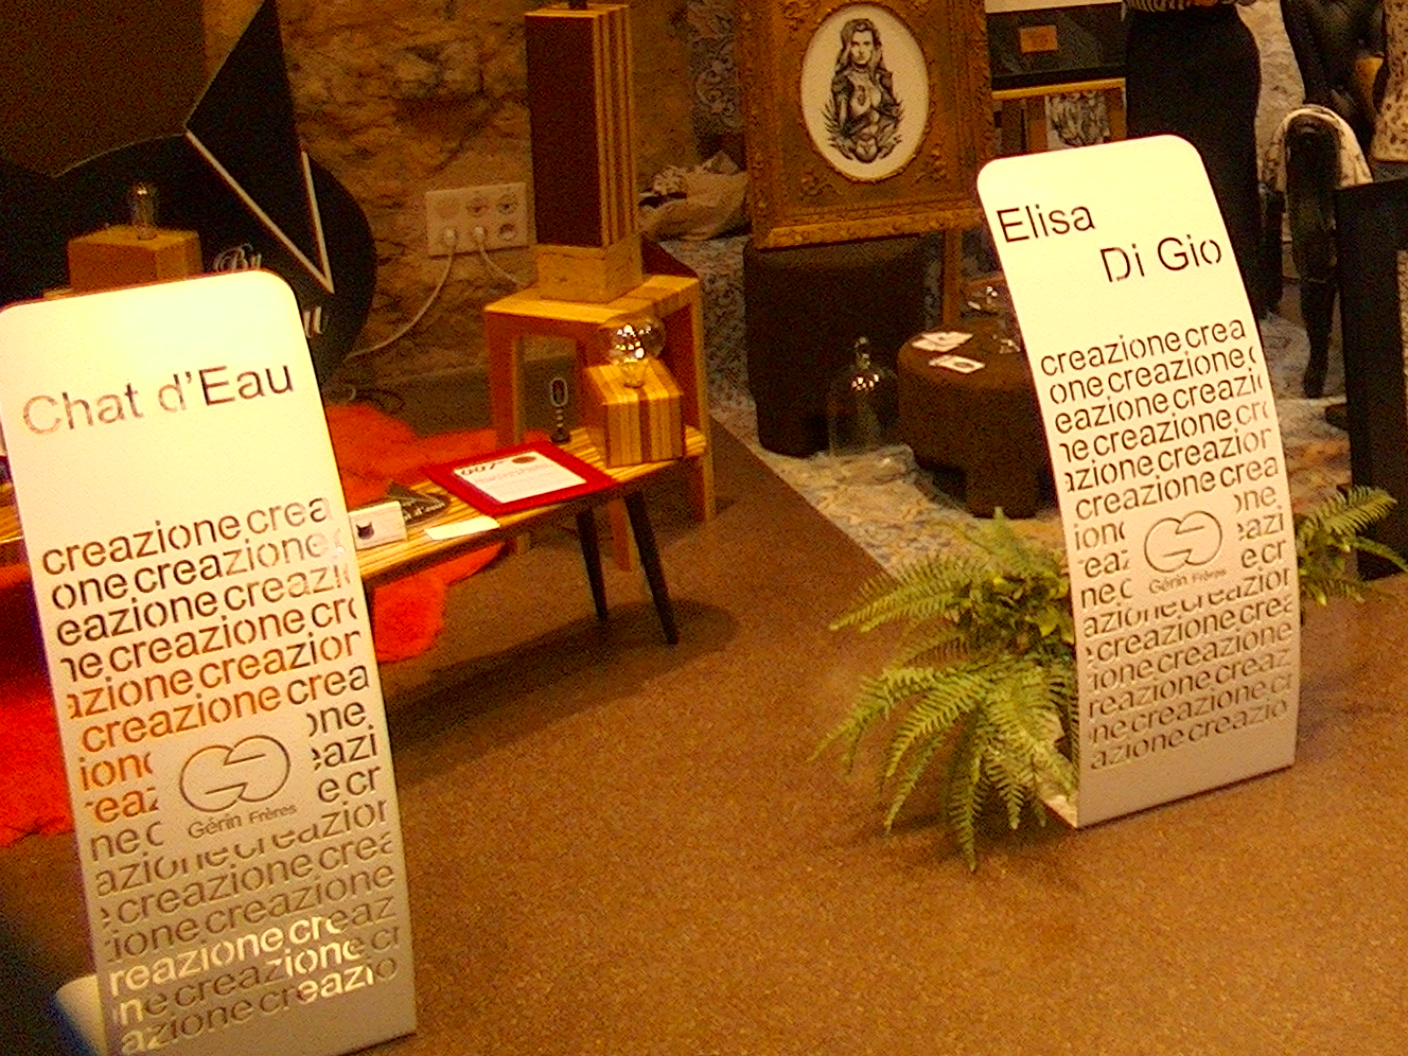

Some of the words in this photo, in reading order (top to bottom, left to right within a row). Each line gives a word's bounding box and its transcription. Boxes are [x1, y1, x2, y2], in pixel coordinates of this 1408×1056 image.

[996, 203, 1097, 243] Elisa
[1099, 243, 1145, 283] Di
[1156, 234, 1222, 271] Gio
[23, 382, 144, 435] Chat
[157, 365, 294, 413] d'Eau
[187, 813, 243, 839] Gérin
[249, 804, 298, 825] Frères
